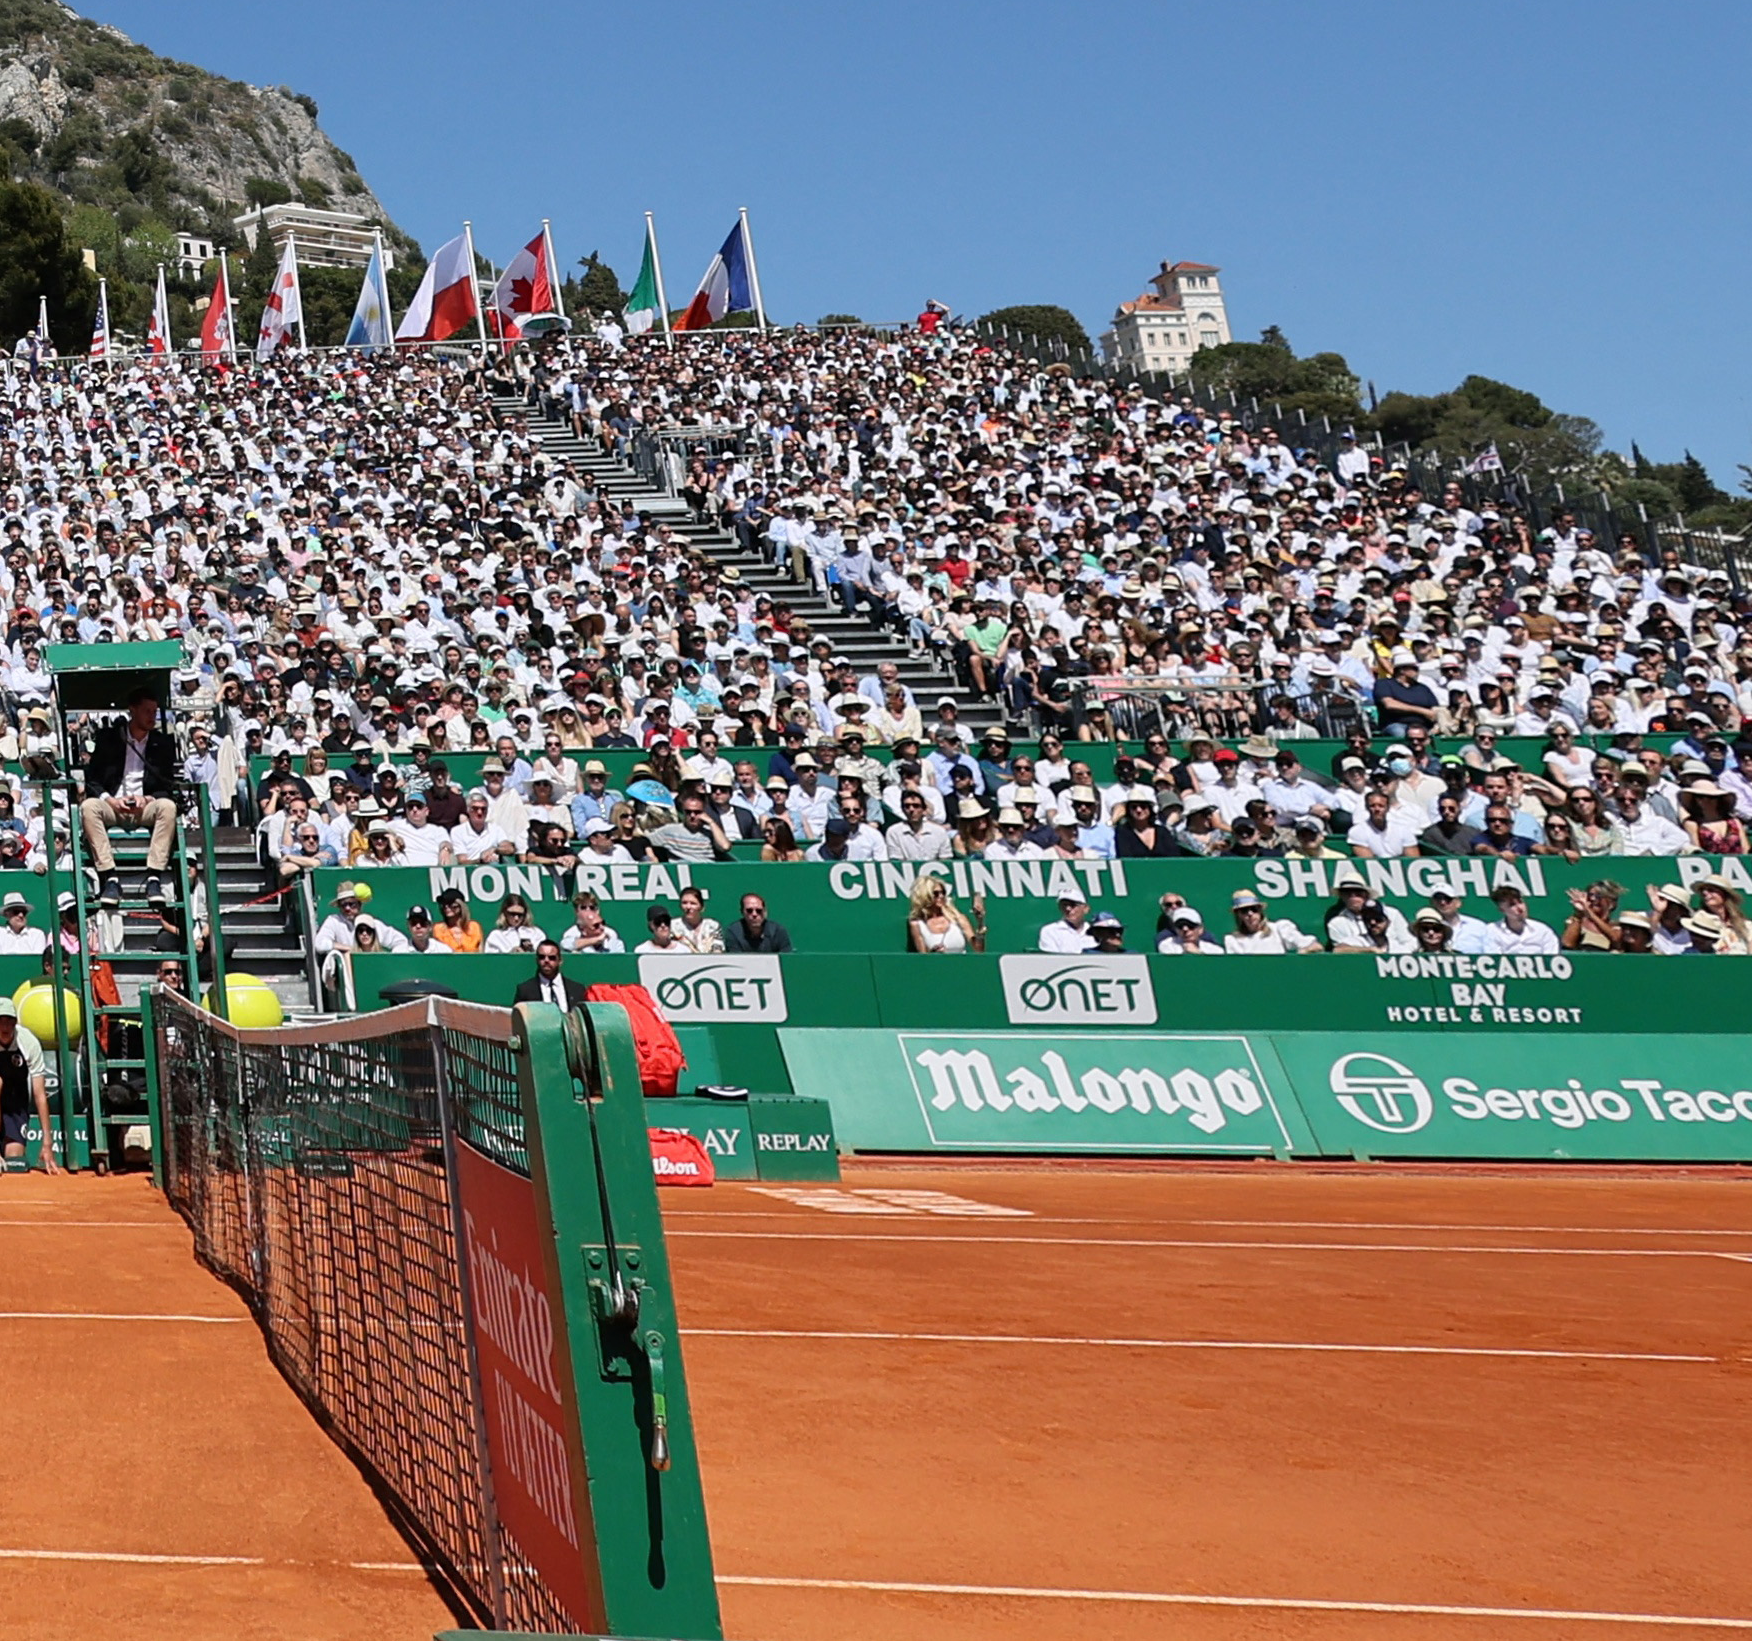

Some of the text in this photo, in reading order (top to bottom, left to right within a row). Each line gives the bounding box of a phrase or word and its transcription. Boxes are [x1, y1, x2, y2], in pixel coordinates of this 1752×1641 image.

[829, 860, 1128, 900] CINCINNATI
[1253, 859, 1548, 898] SHANGHAI
[1376, 956, 1574, 980] MONTE-CARLO
[1450, 983, 1507, 1007] BAY
[1387, 1007, 1583, 1024] HOTEL & RESORT
[915, 1049, 1263, 1134] Malongo
[1443, 1077, 1632, 1129] Sergio
[758, 1133, 831, 1152] REPLAY
[652, 1156, 700, 1175] ilson
